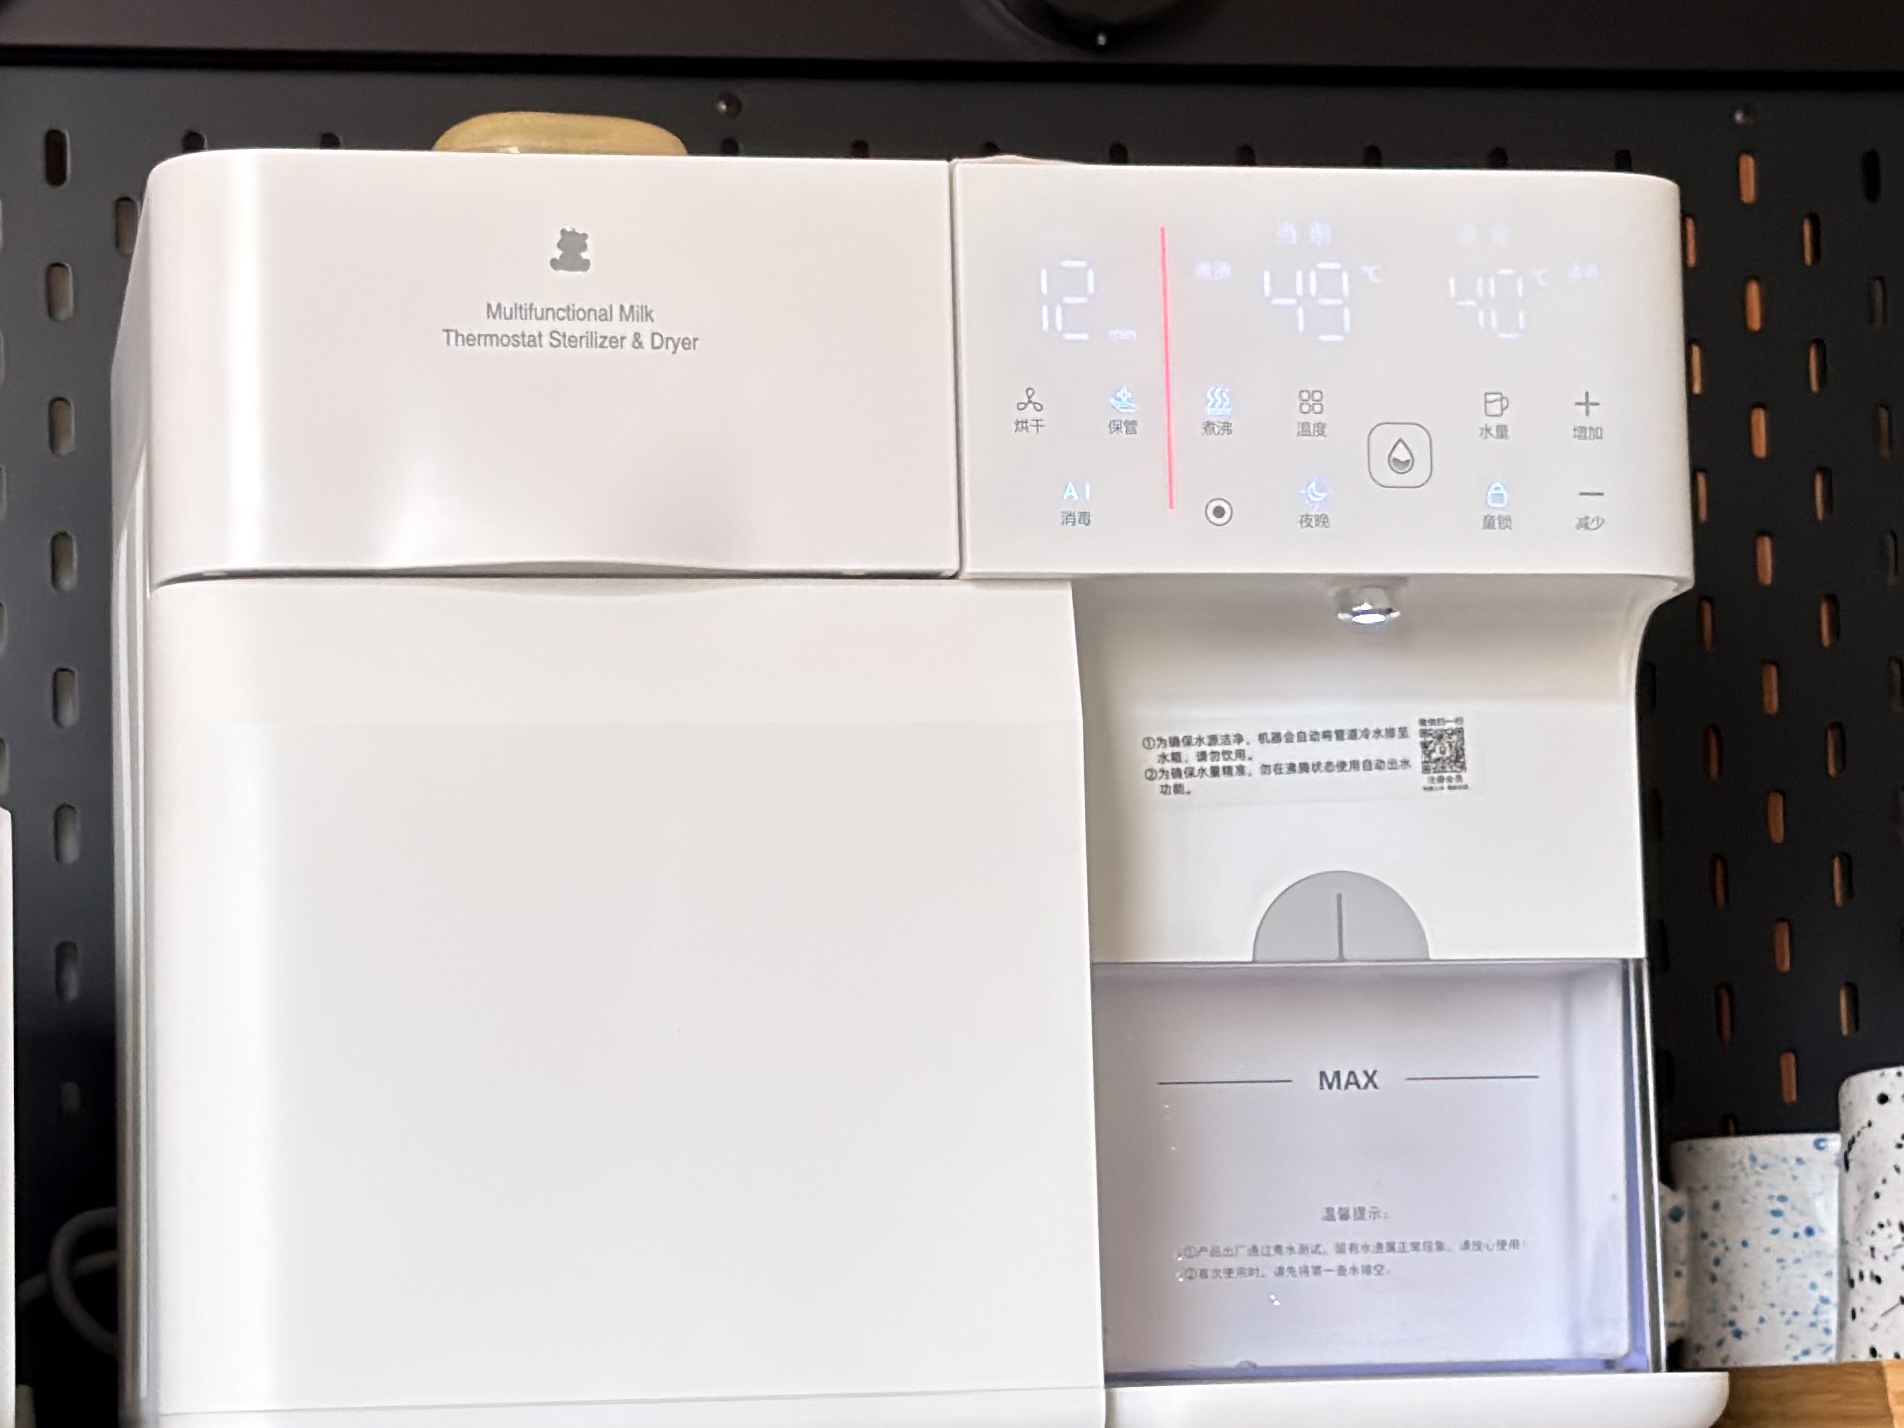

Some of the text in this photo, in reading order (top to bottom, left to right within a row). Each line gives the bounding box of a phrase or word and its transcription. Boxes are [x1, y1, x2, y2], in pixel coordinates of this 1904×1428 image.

[1262, 261, 1351, 343] 49
[486, 301, 655, 323] Multifunctional Milk
[442, 327, 700, 355] Thermostat Sterilizer & Dryer
[1013, 418, 1046, 434] 烘干
[1107, 419, 1139, 435] 保管
[1201, 420, 1233, 437] 煮沸
[1296, 421, 1328, 438] 温度
[1478, 424, 1509, 440] 水量
[1572, 425, 1604, 441] 增加
[1060, 510, 1092, 527] 消毒
[1297, 513, 1331, 529] 夜晚
[1481, 514, 1513, 531] 童锁
[1575, 515, 1606, 531] 减少
[1318, 1068, 1380, 1092] MAX
